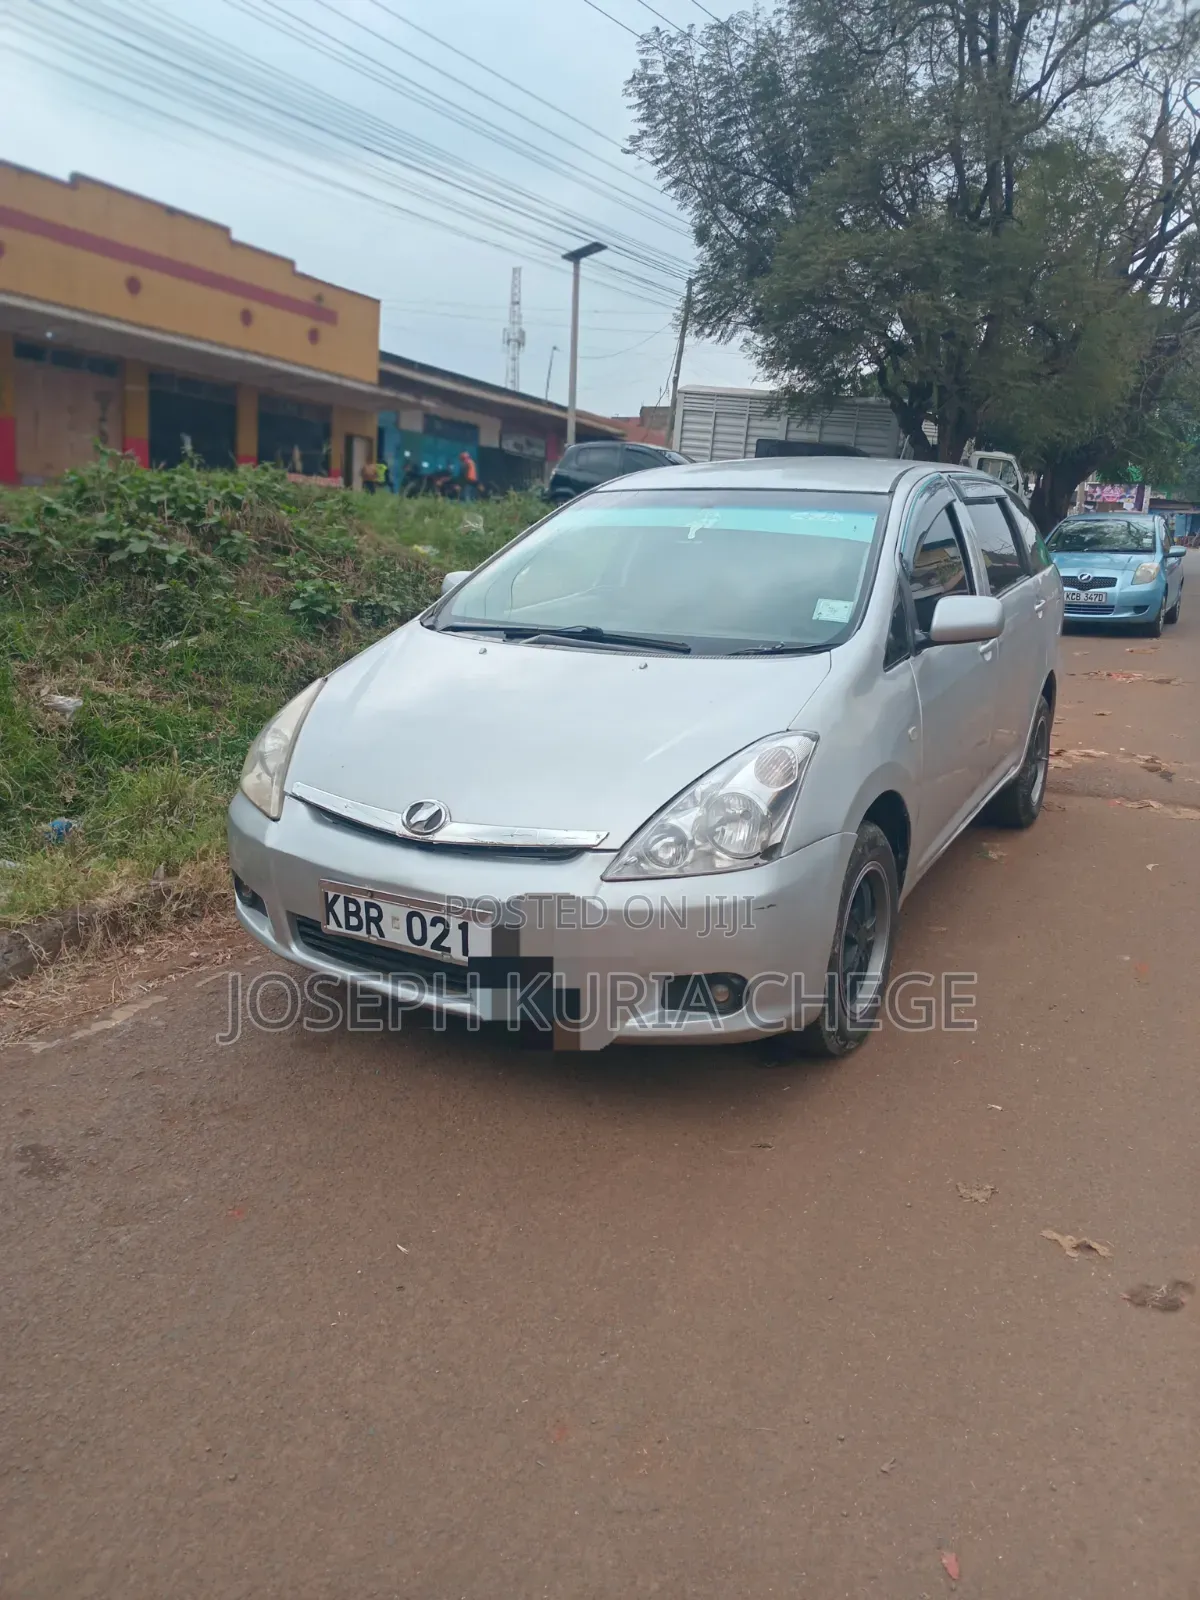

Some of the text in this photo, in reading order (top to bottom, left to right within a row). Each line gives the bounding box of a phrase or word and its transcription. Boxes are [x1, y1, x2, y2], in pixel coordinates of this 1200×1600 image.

[1065, 592, 1104, 602] KCB 347D
[324, 891, 469, 957] KBR 021
